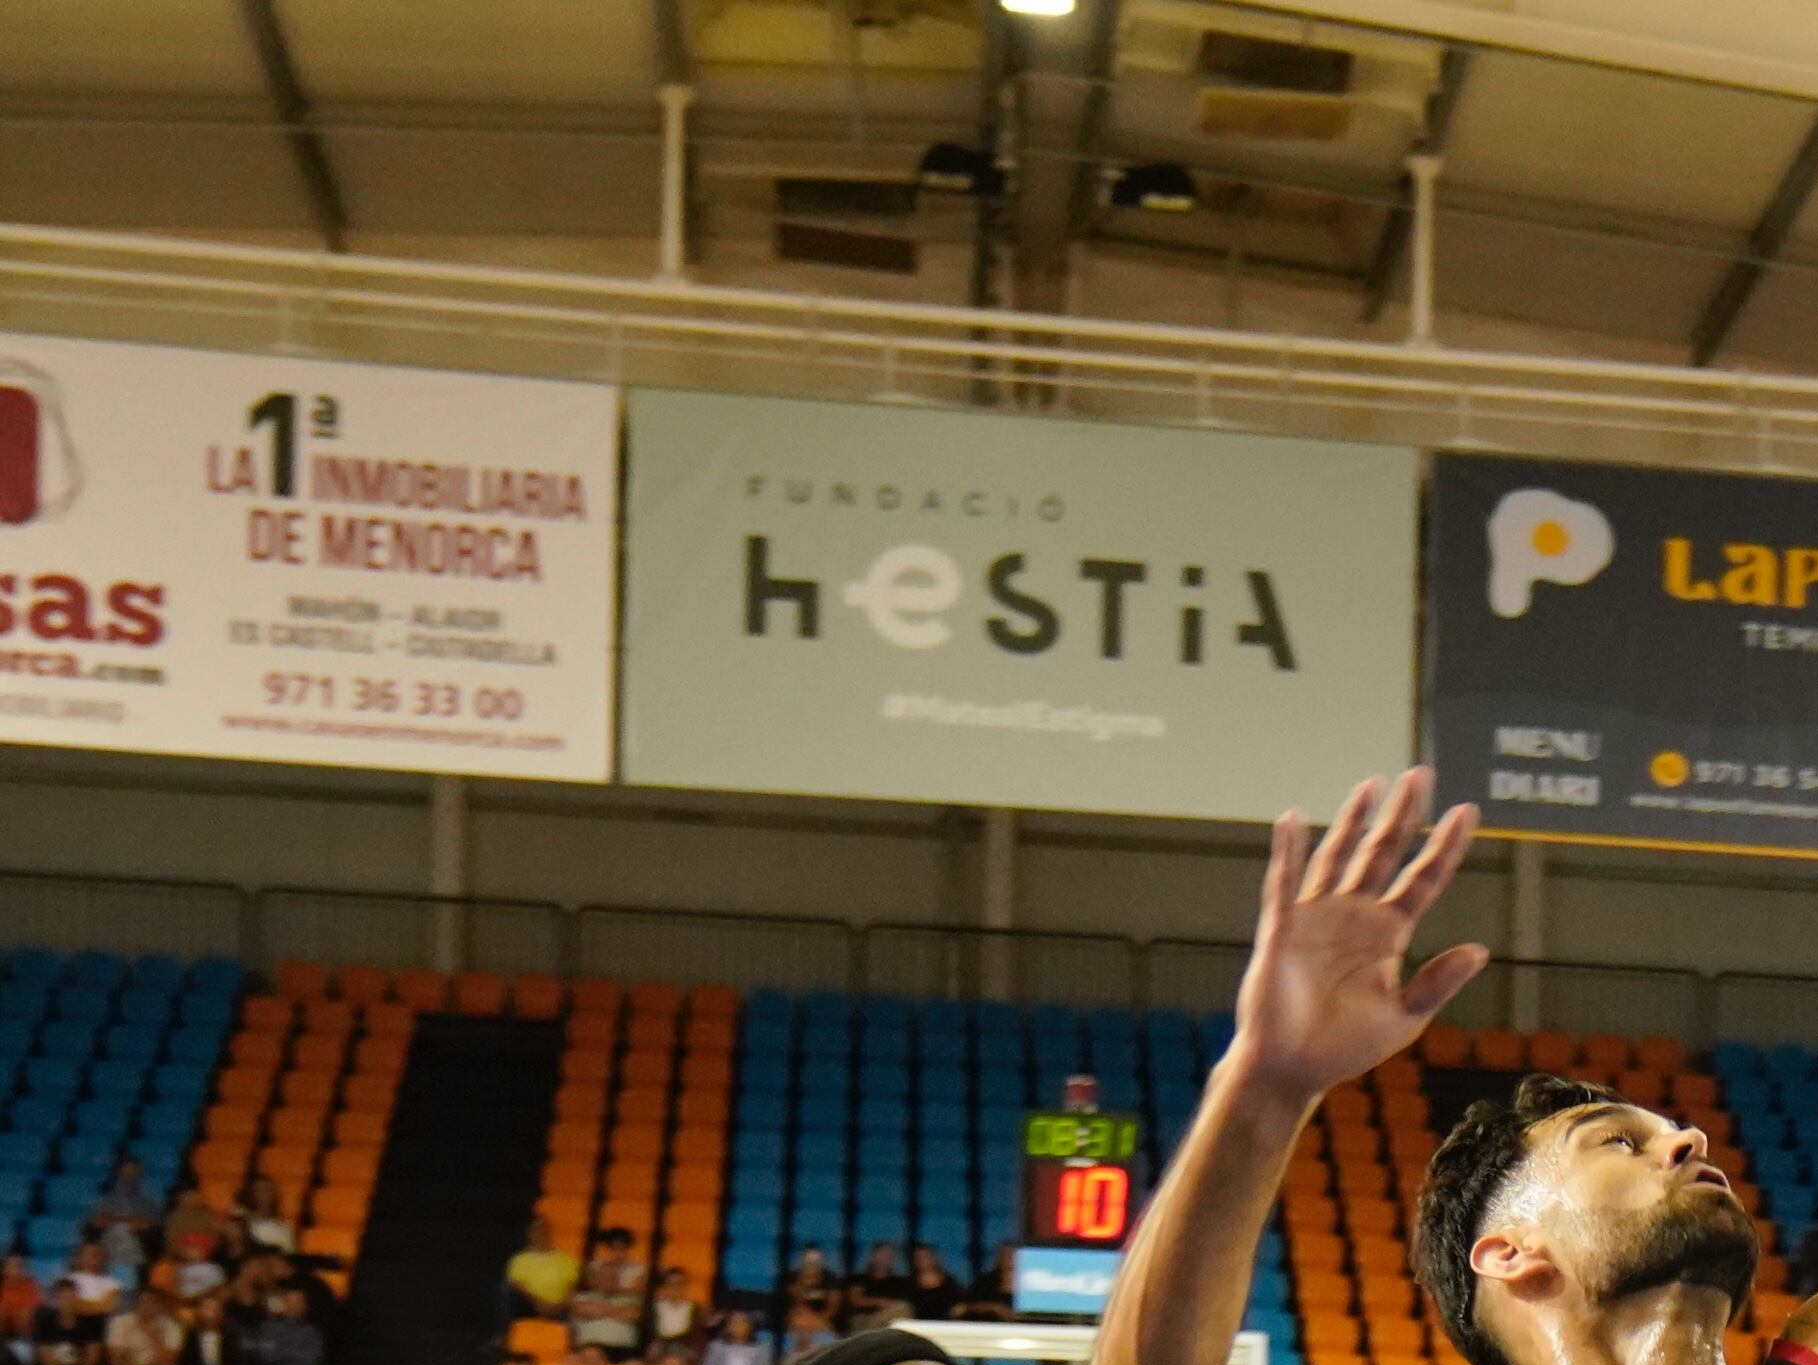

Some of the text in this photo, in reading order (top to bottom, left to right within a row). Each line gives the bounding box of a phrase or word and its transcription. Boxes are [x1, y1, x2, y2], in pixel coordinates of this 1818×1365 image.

[206, 445, 257, 493] LA
[312, 454, 588, 522] INMOBILIARIA
[746, 474, 1068, 523] FUNDACIÓ
[247, 507, 541, 582] DE MENORCA
[261, 670, 524, 721] 971 36 33 00
[1057, 1167, 1129, 1240] 10
